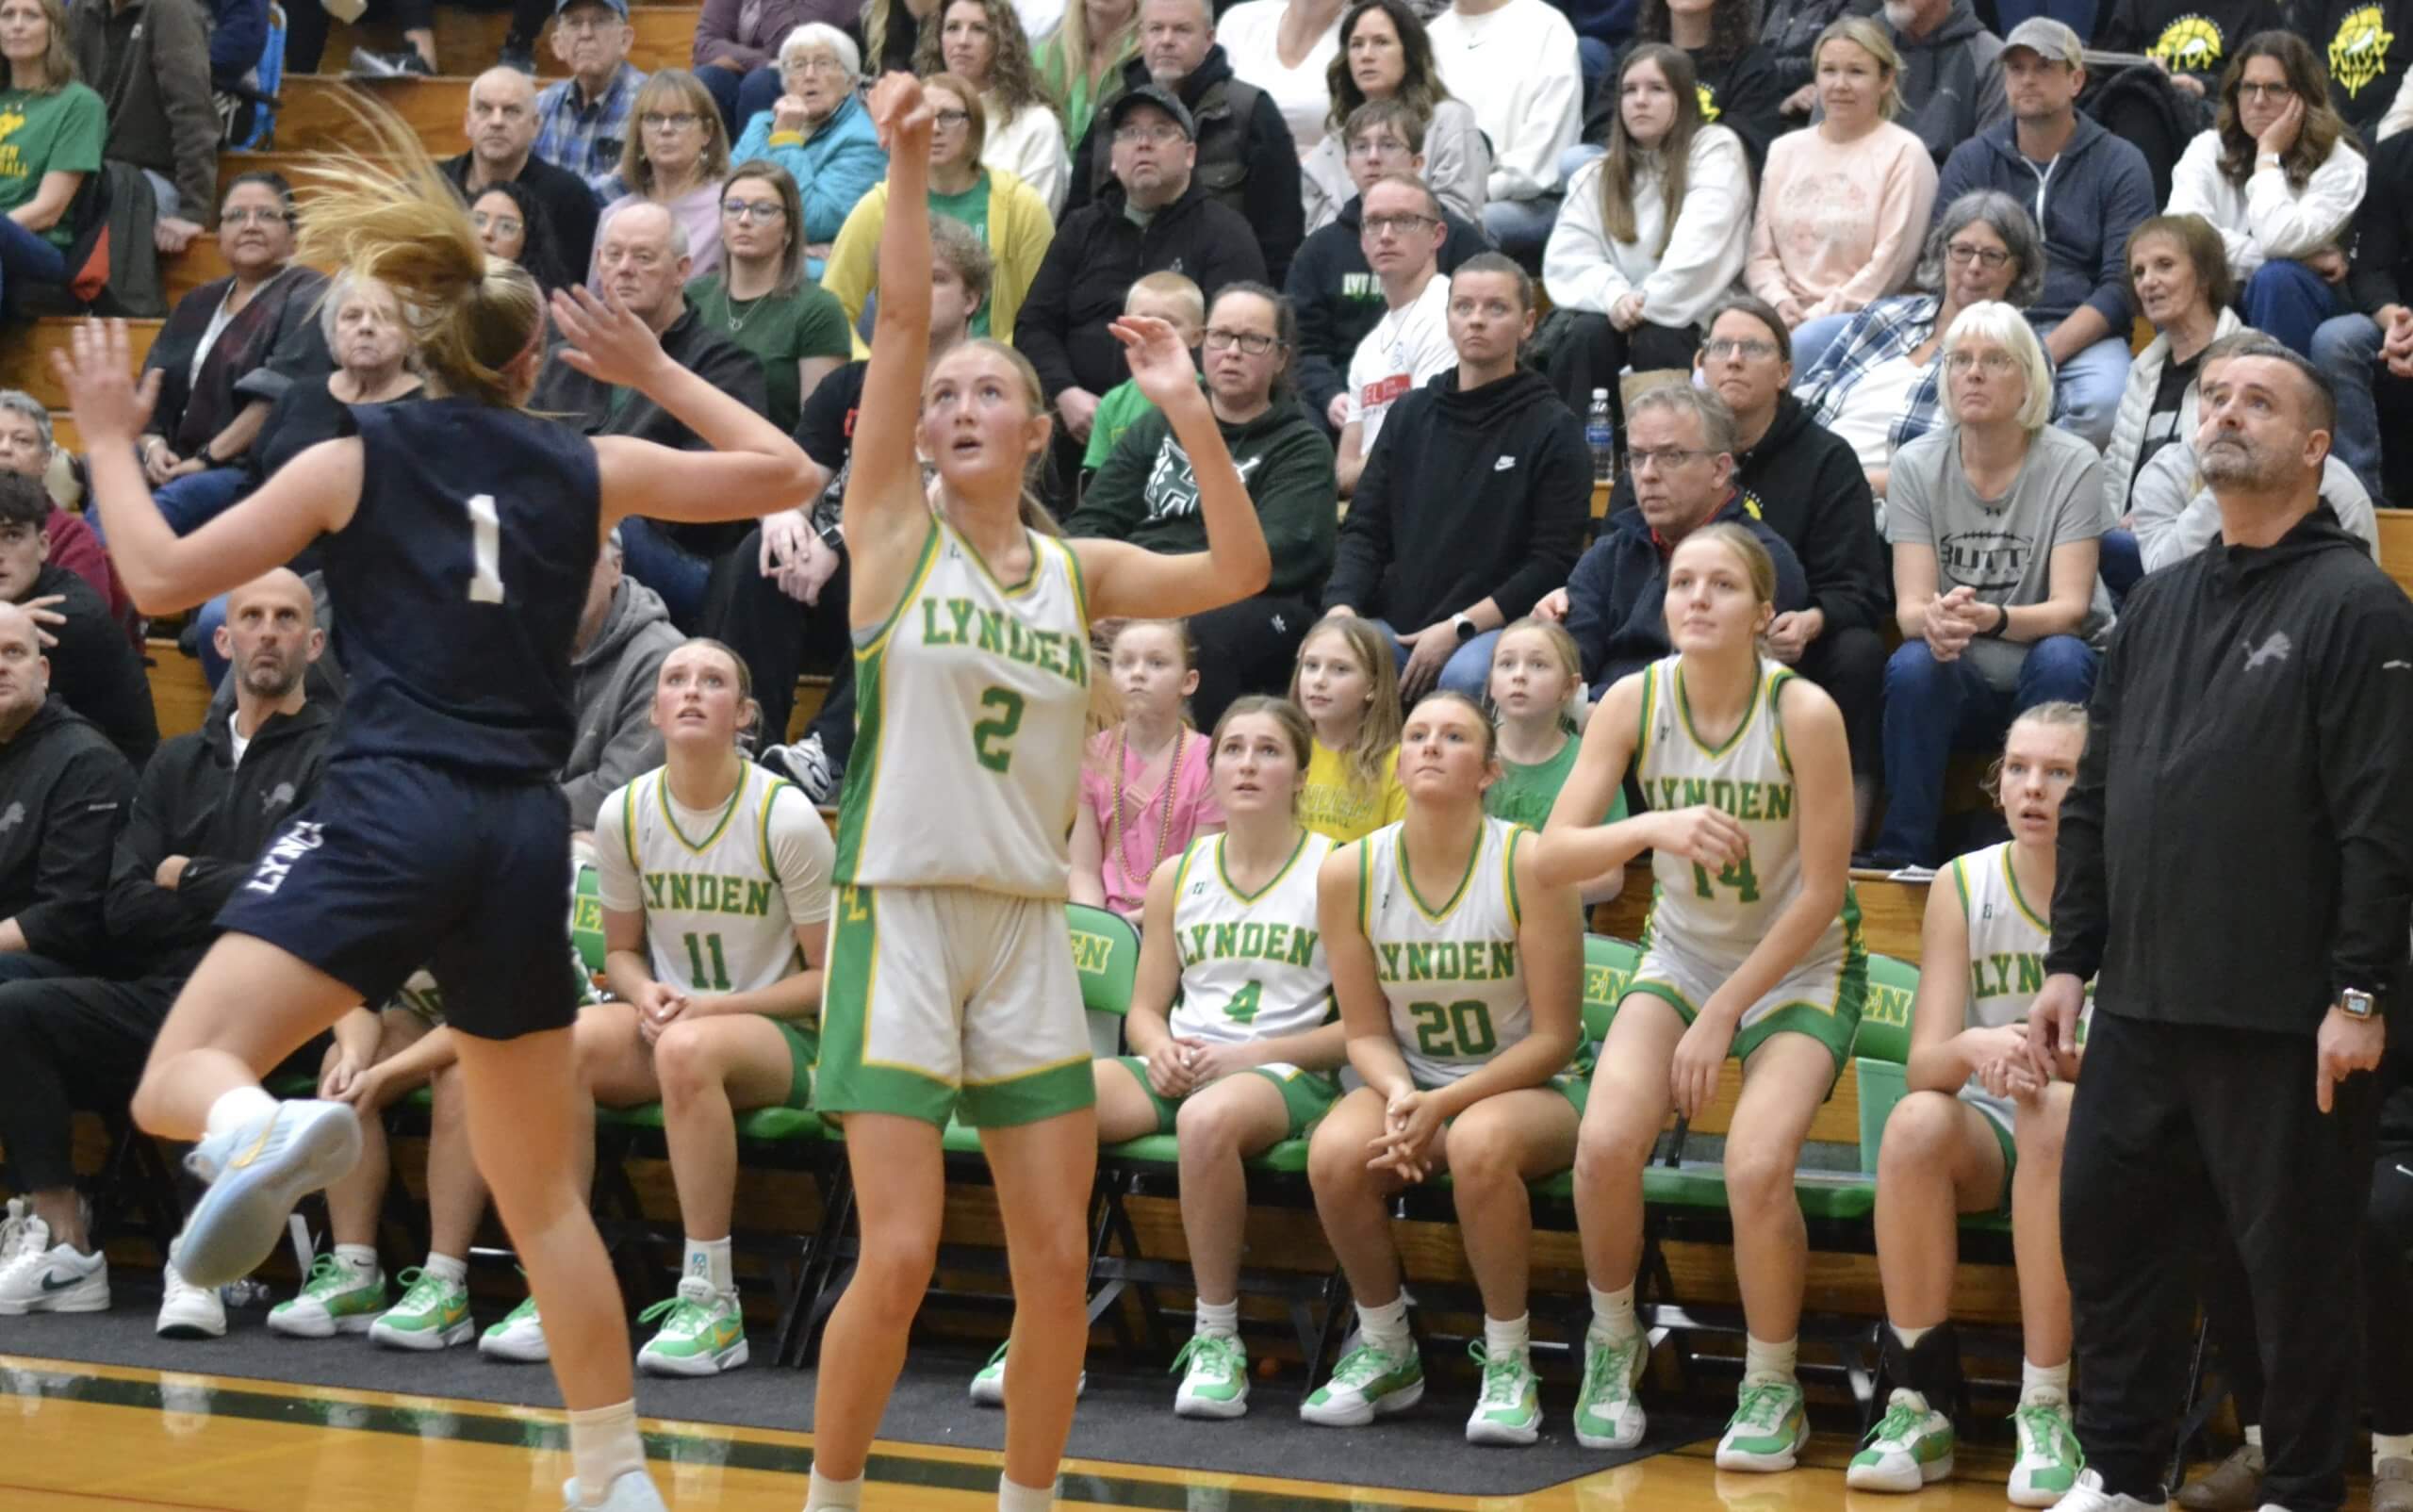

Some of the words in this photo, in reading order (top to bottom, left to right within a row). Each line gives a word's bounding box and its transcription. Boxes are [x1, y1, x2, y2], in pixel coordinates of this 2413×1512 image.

[468, 494, 505, 603] 1
[974, 685, 1026, 773] 2
[682, 932, 731, 990] 11
[1175, 921, 1320, 968] LYNDEN
[1223, 978, 1262, 1025] 4
[1973, 952, 2045, 997] LYN
[1409, 1000, 1497, 1056] 20
